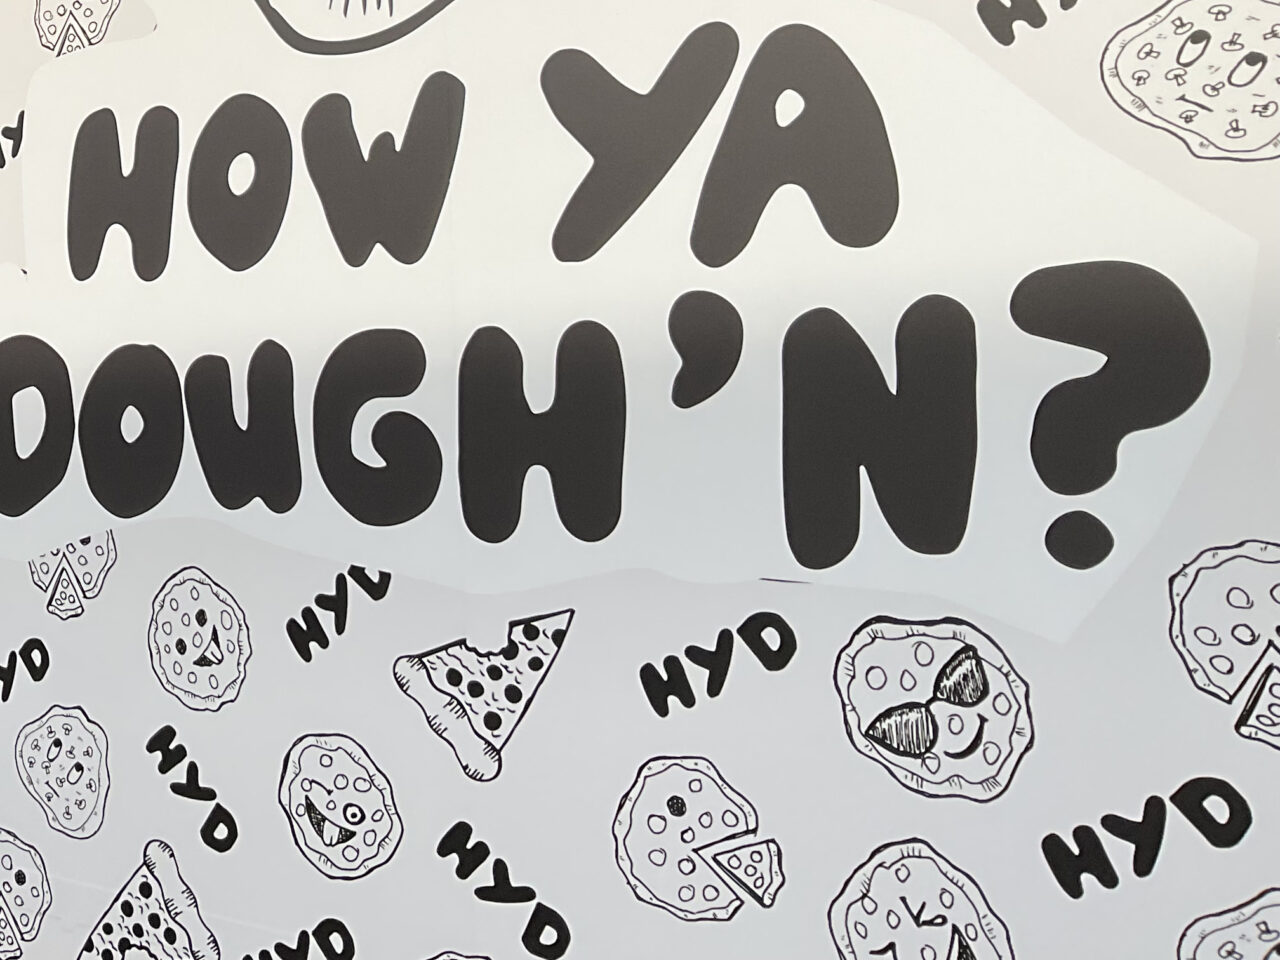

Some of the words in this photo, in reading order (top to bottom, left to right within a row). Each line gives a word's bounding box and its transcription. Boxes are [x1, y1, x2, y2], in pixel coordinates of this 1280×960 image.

[68, 71, 466, 281] HOW
[540, 21, 900, 268] YA
[640, 612, 797, 717] HYD
[146, 725, 238, 852] HYD
[1042, 777, 1253, 899] HYD
[437, 821, 571, 959] HYD
